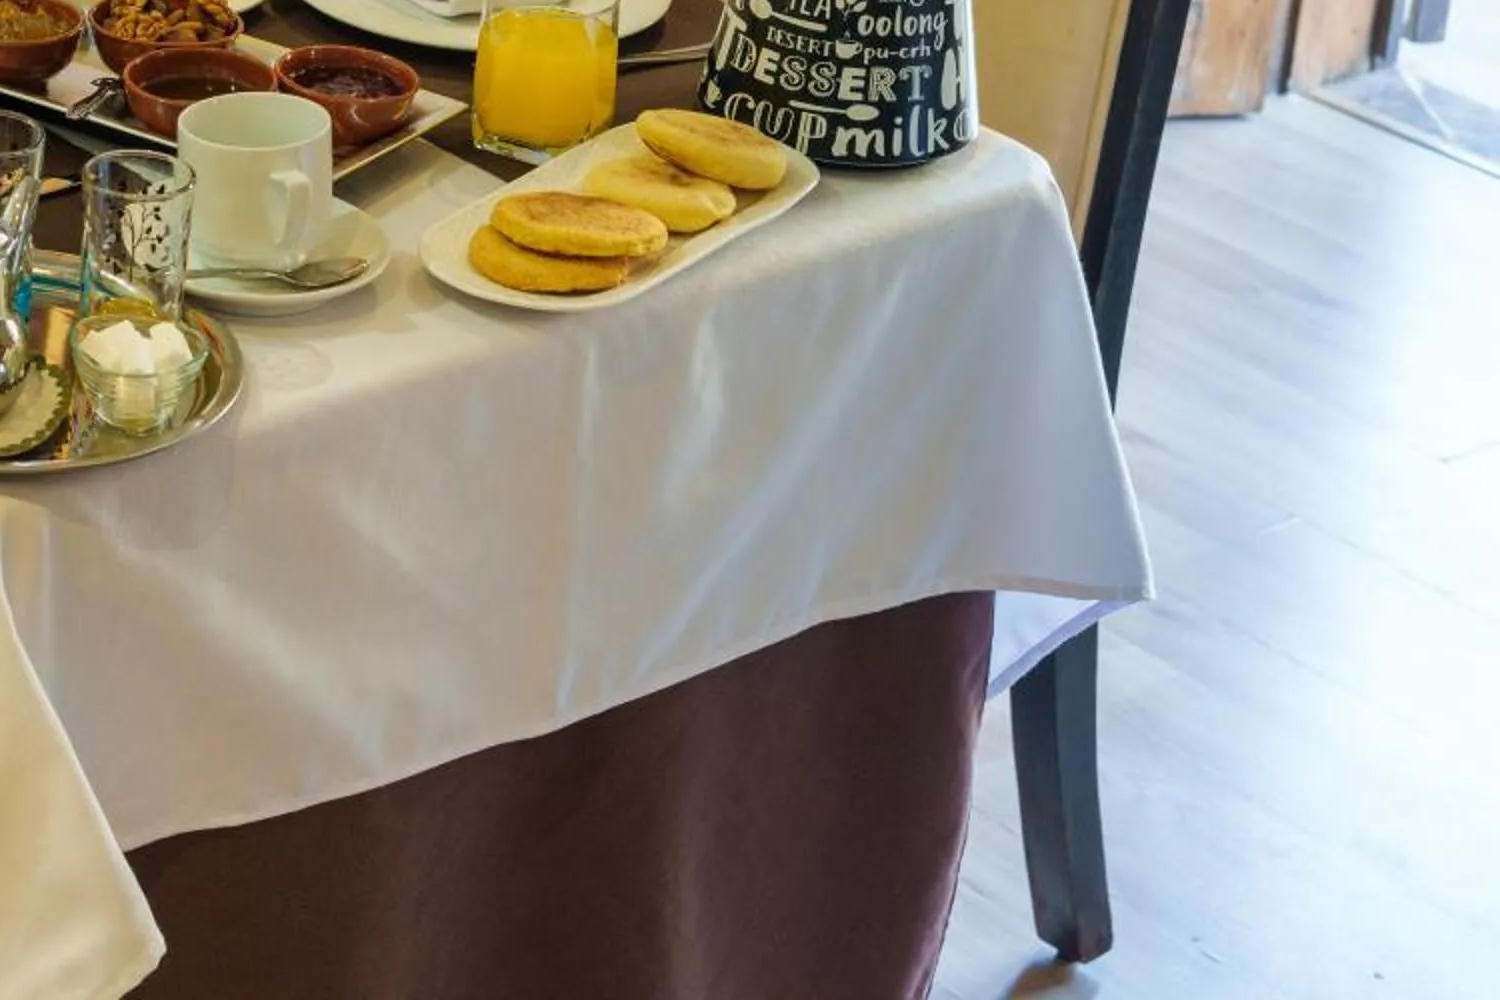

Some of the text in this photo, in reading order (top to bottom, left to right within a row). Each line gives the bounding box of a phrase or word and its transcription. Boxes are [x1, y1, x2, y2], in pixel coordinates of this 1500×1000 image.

[766, 25, 834, 57] DESERT
[857, 4, 948, 50] oolong
[730, 33, 932, 102] DESSERT
[724, 92, 827, 155] CUP
[832, 104, 949, 157] milk
